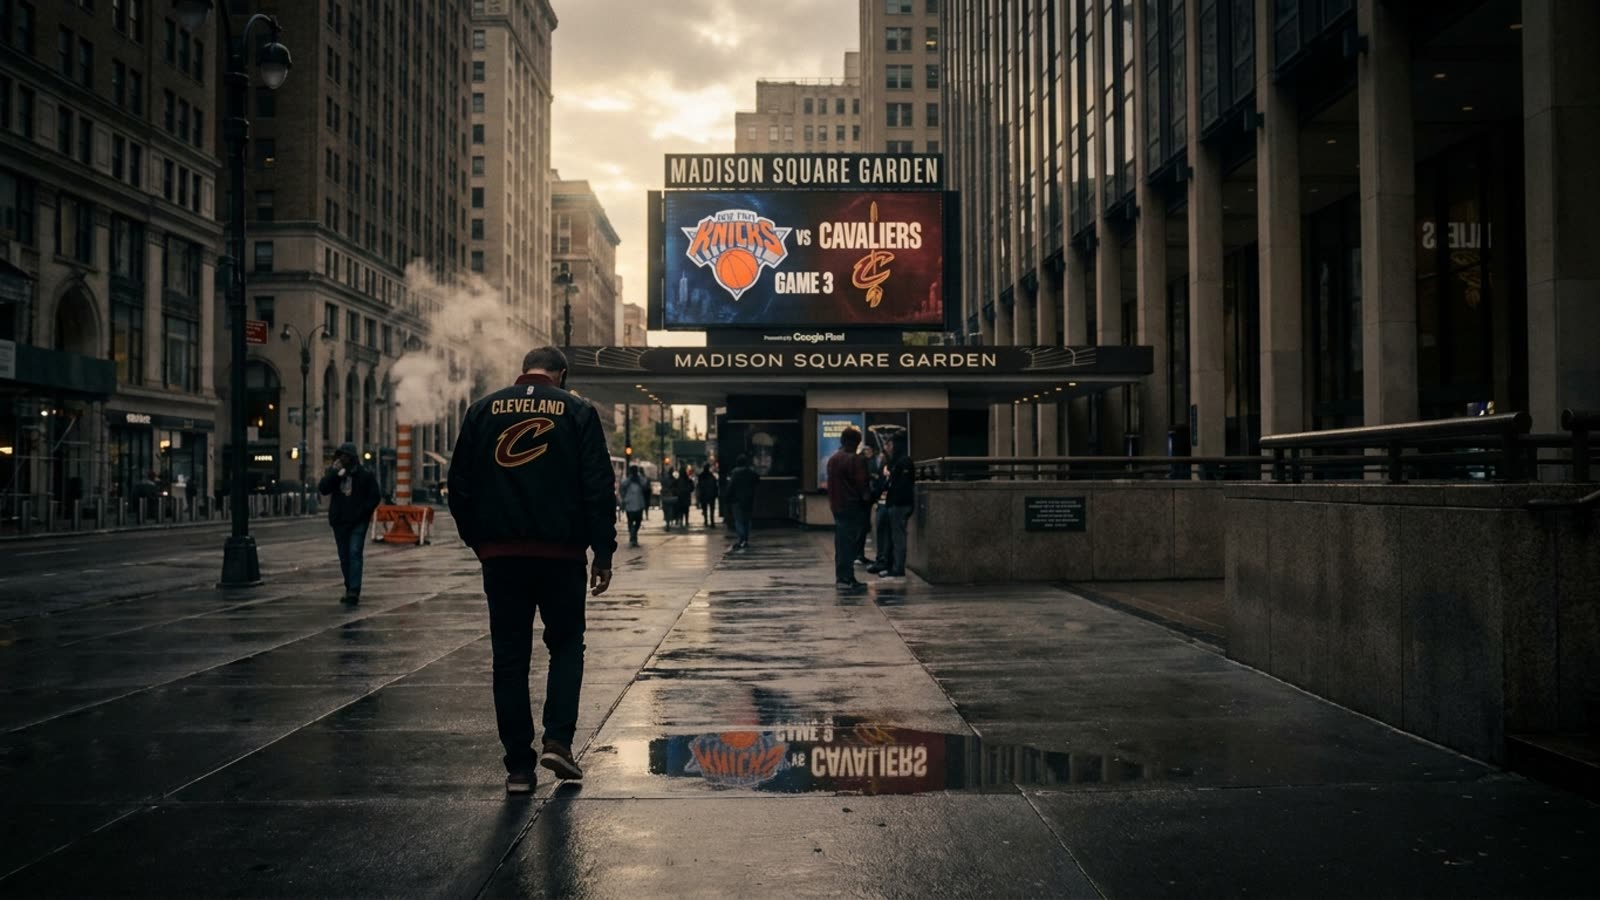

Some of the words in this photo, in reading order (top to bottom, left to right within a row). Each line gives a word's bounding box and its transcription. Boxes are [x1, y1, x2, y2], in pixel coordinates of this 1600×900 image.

[671, 157, 764, 183] MADISON
[772, 157, 850, 185] SQUARE
[859, 157, 938, 183] GARDEN
[690, 219, 784, 257] KNICKS
[819, 221, 922, 249] CAVALIERS
[775, 272, 820, 294] GAME
[823, 272, 834, 294] 3
[674, 353, 783, 367] MADISON
[793, 353, 890, 369] SQUARE
[899, 353, 997, 367] GARDEN
[491, 399, 565, 415] CLEVELAND
[495, 417, 555, 467] C
